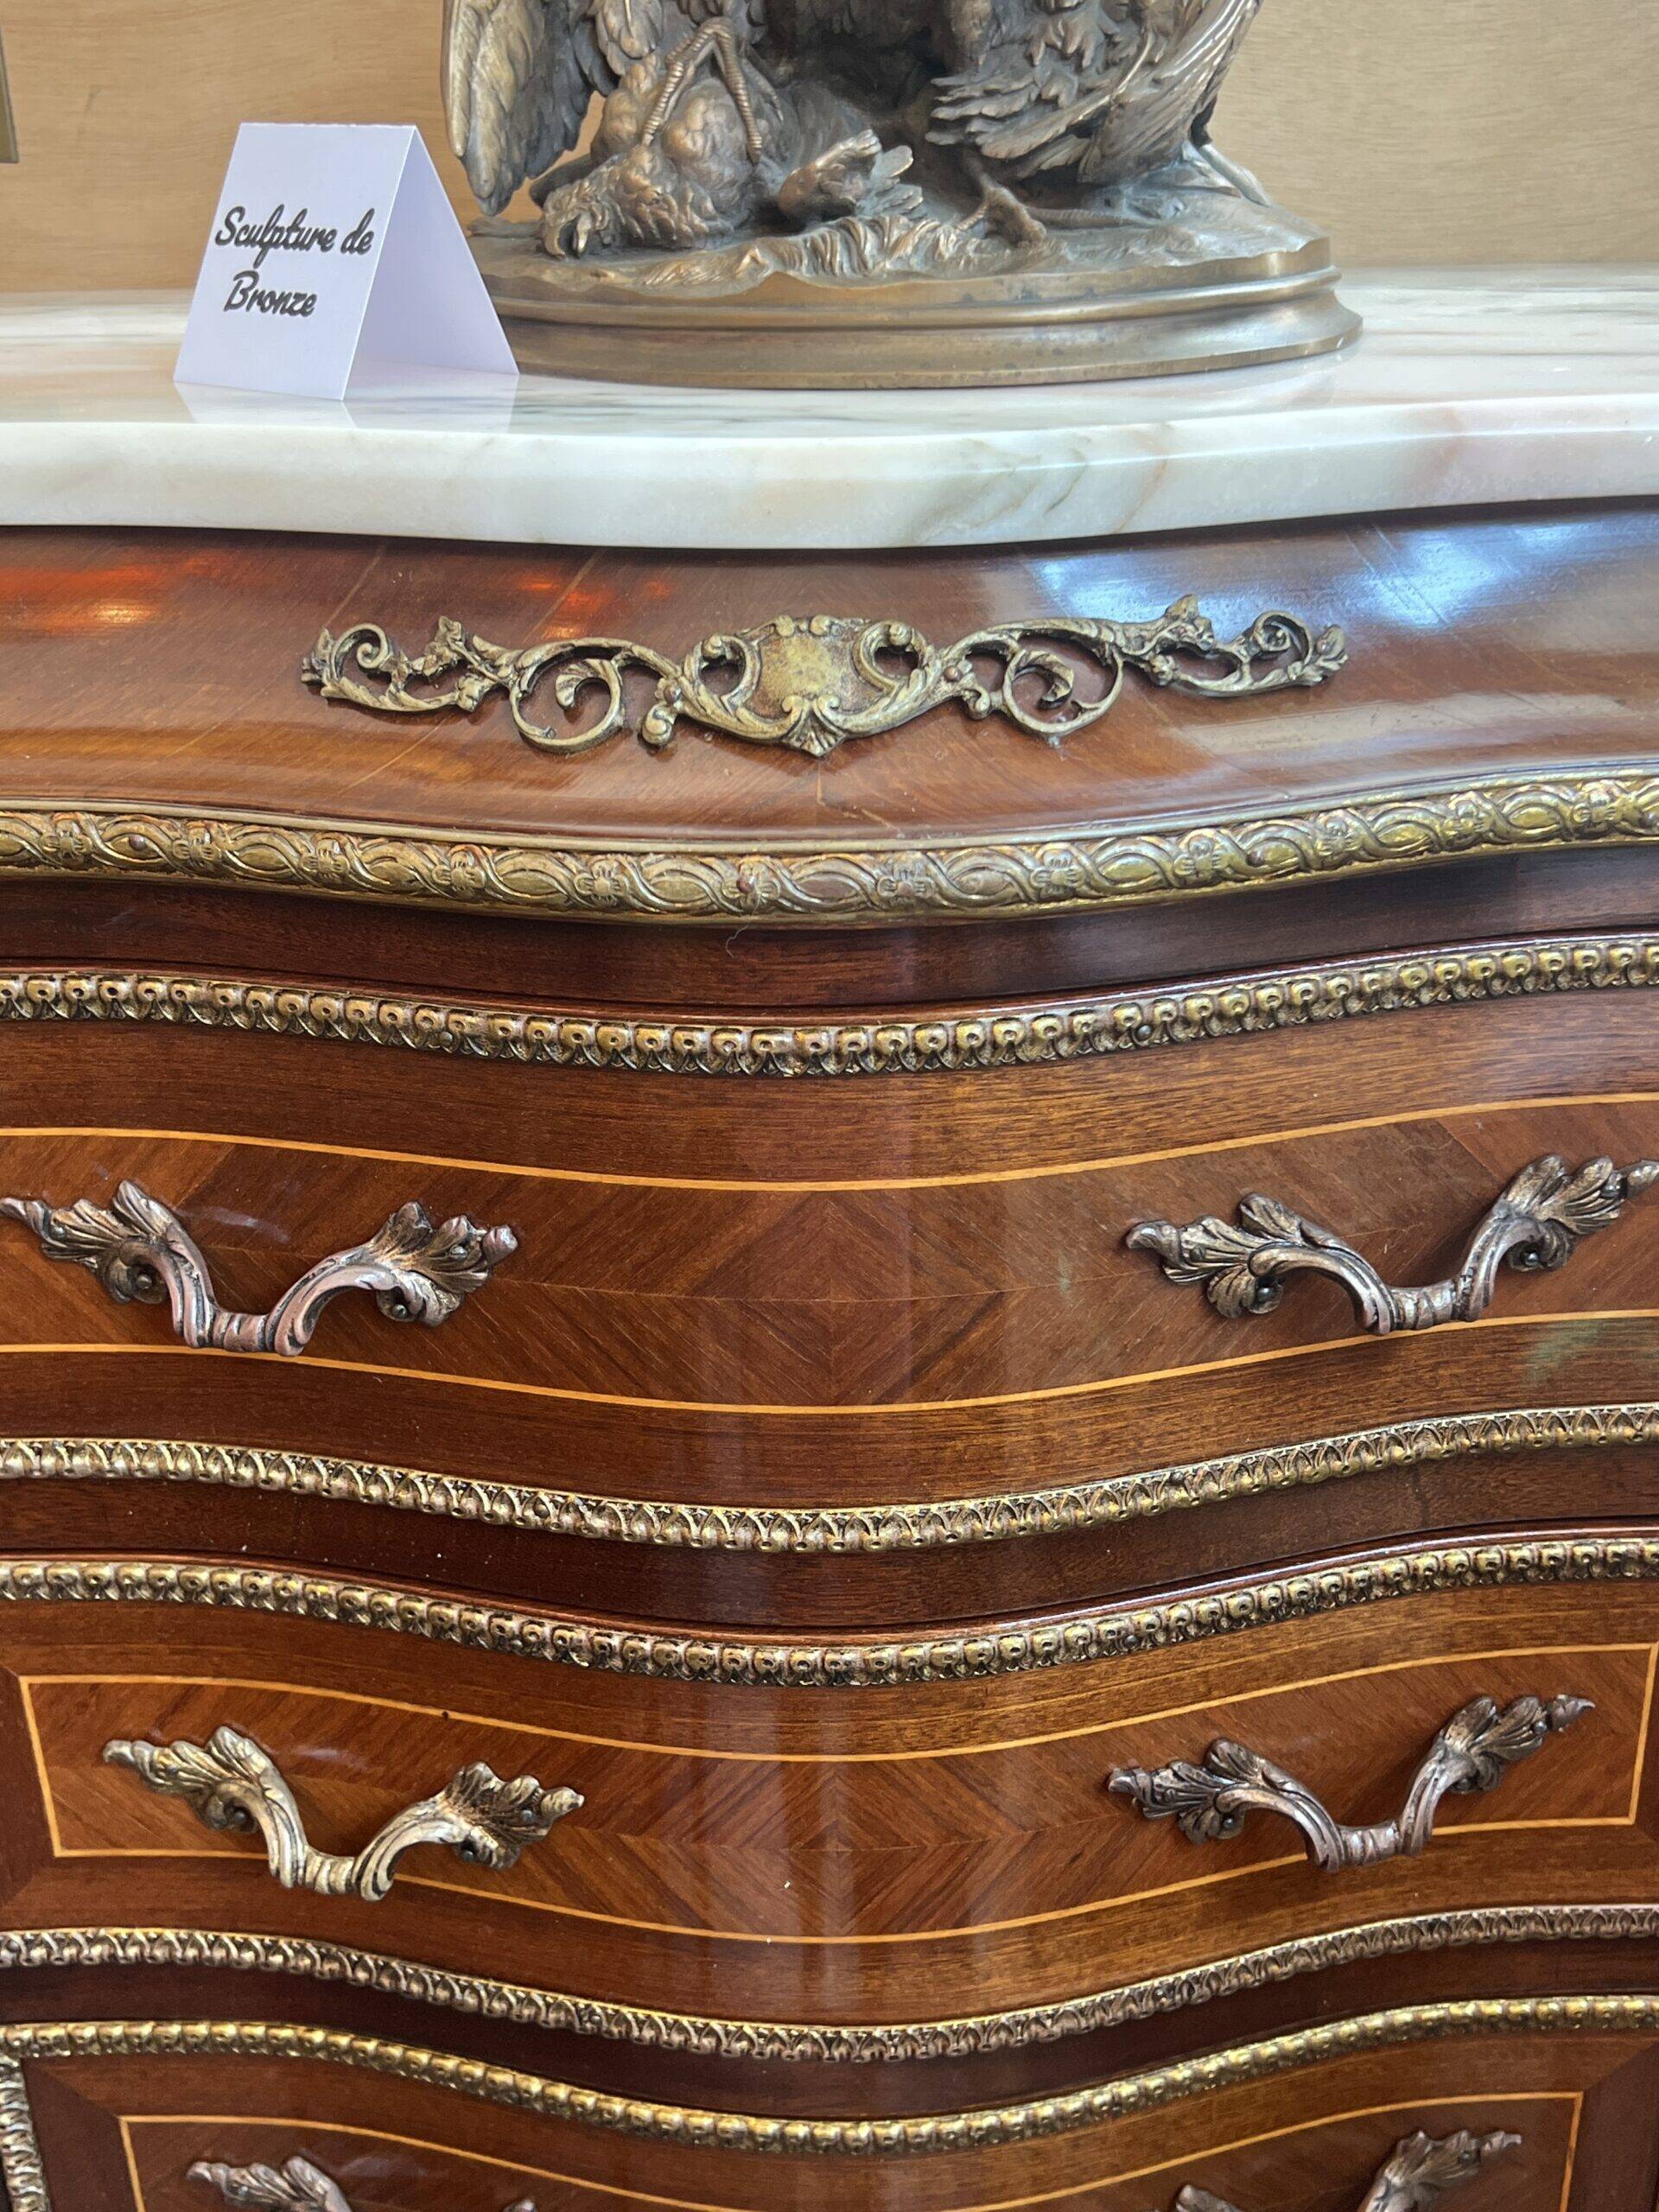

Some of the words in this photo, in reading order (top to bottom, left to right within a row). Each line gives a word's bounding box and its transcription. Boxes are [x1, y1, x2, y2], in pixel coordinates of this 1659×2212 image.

[214, 204, 338, 269] Sculpture
[340, 207, 375, 255] de
[223, 270, 317, 317] Bronze
